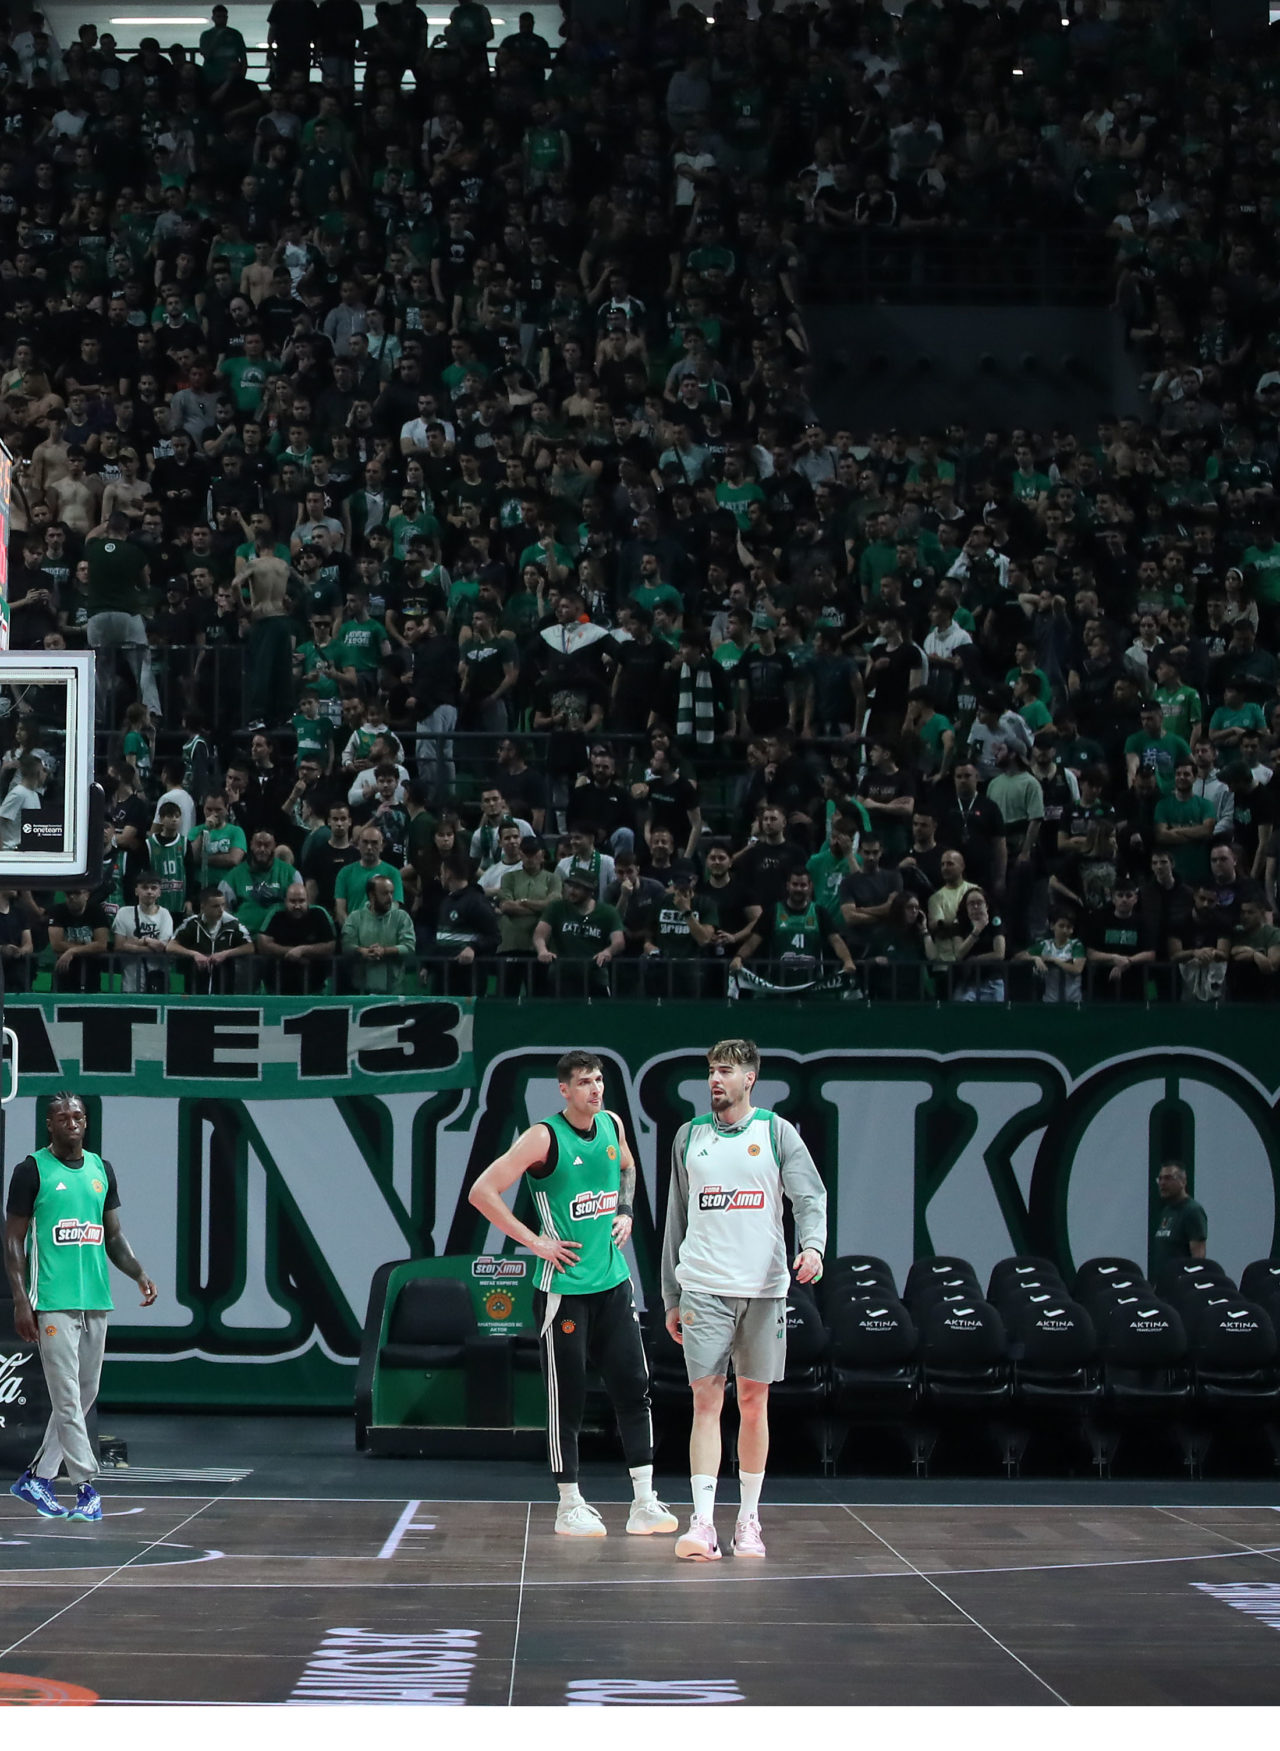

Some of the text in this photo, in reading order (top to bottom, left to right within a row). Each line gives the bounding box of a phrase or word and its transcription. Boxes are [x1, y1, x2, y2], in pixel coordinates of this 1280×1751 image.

[791, 933, 805, 949] 41
[280, 1000, 463, 1080] 13
[944, 1319, 983, 1327] AKTINA
